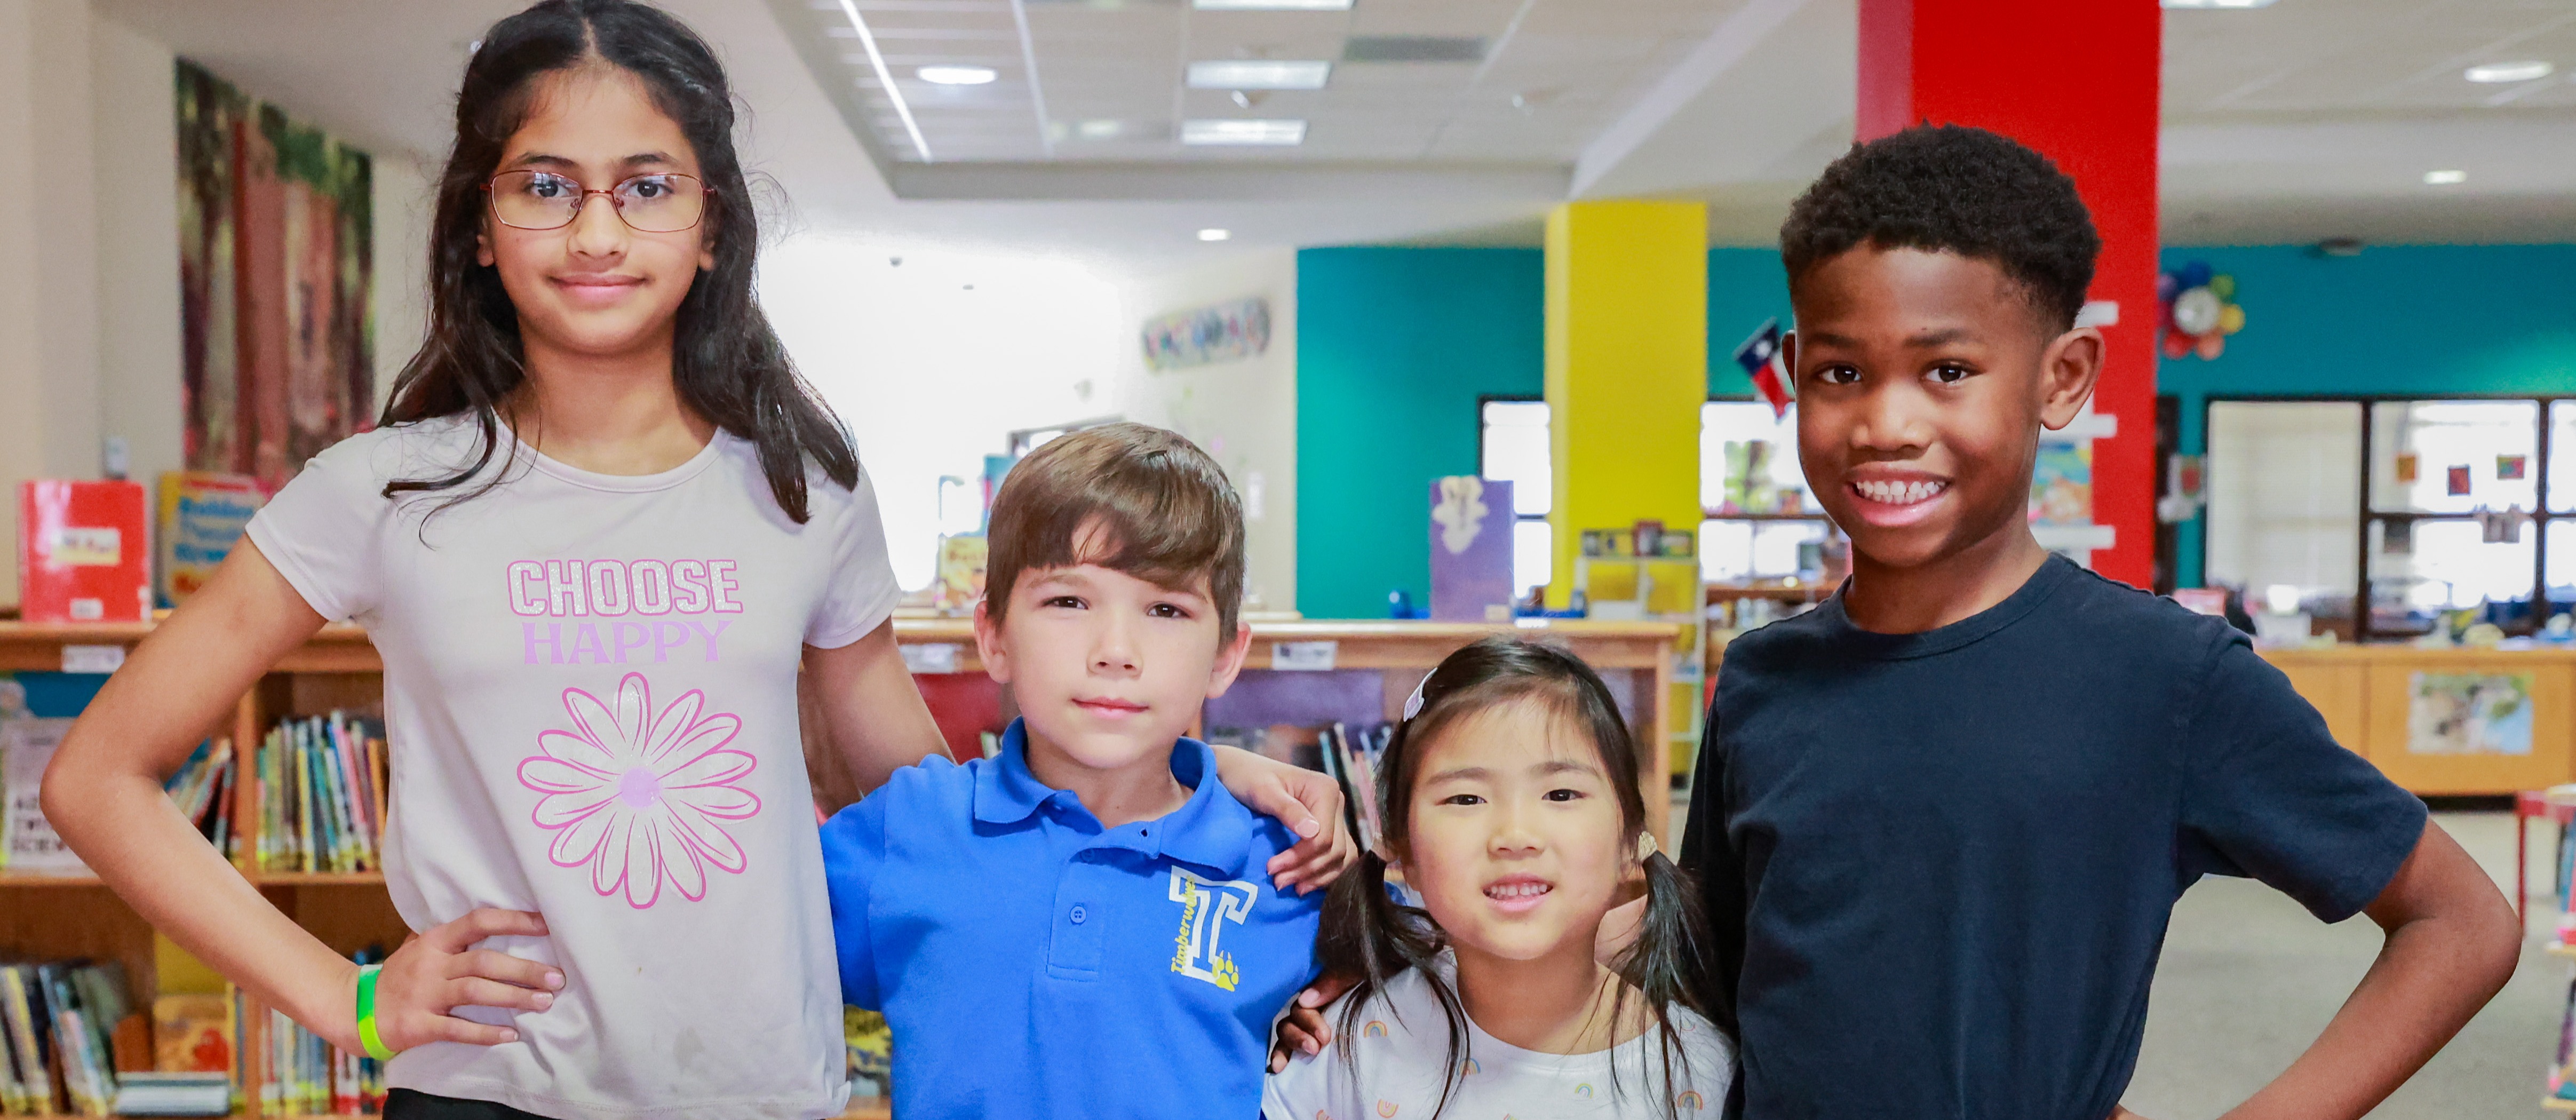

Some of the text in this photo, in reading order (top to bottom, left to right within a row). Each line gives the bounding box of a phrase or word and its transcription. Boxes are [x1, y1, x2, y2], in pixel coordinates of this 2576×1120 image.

[507, 559, 743, 616] CHOOSE
[521, 619, 734, 665] HAPPY
[1171, 875, 1198, 973] Timberwolves
